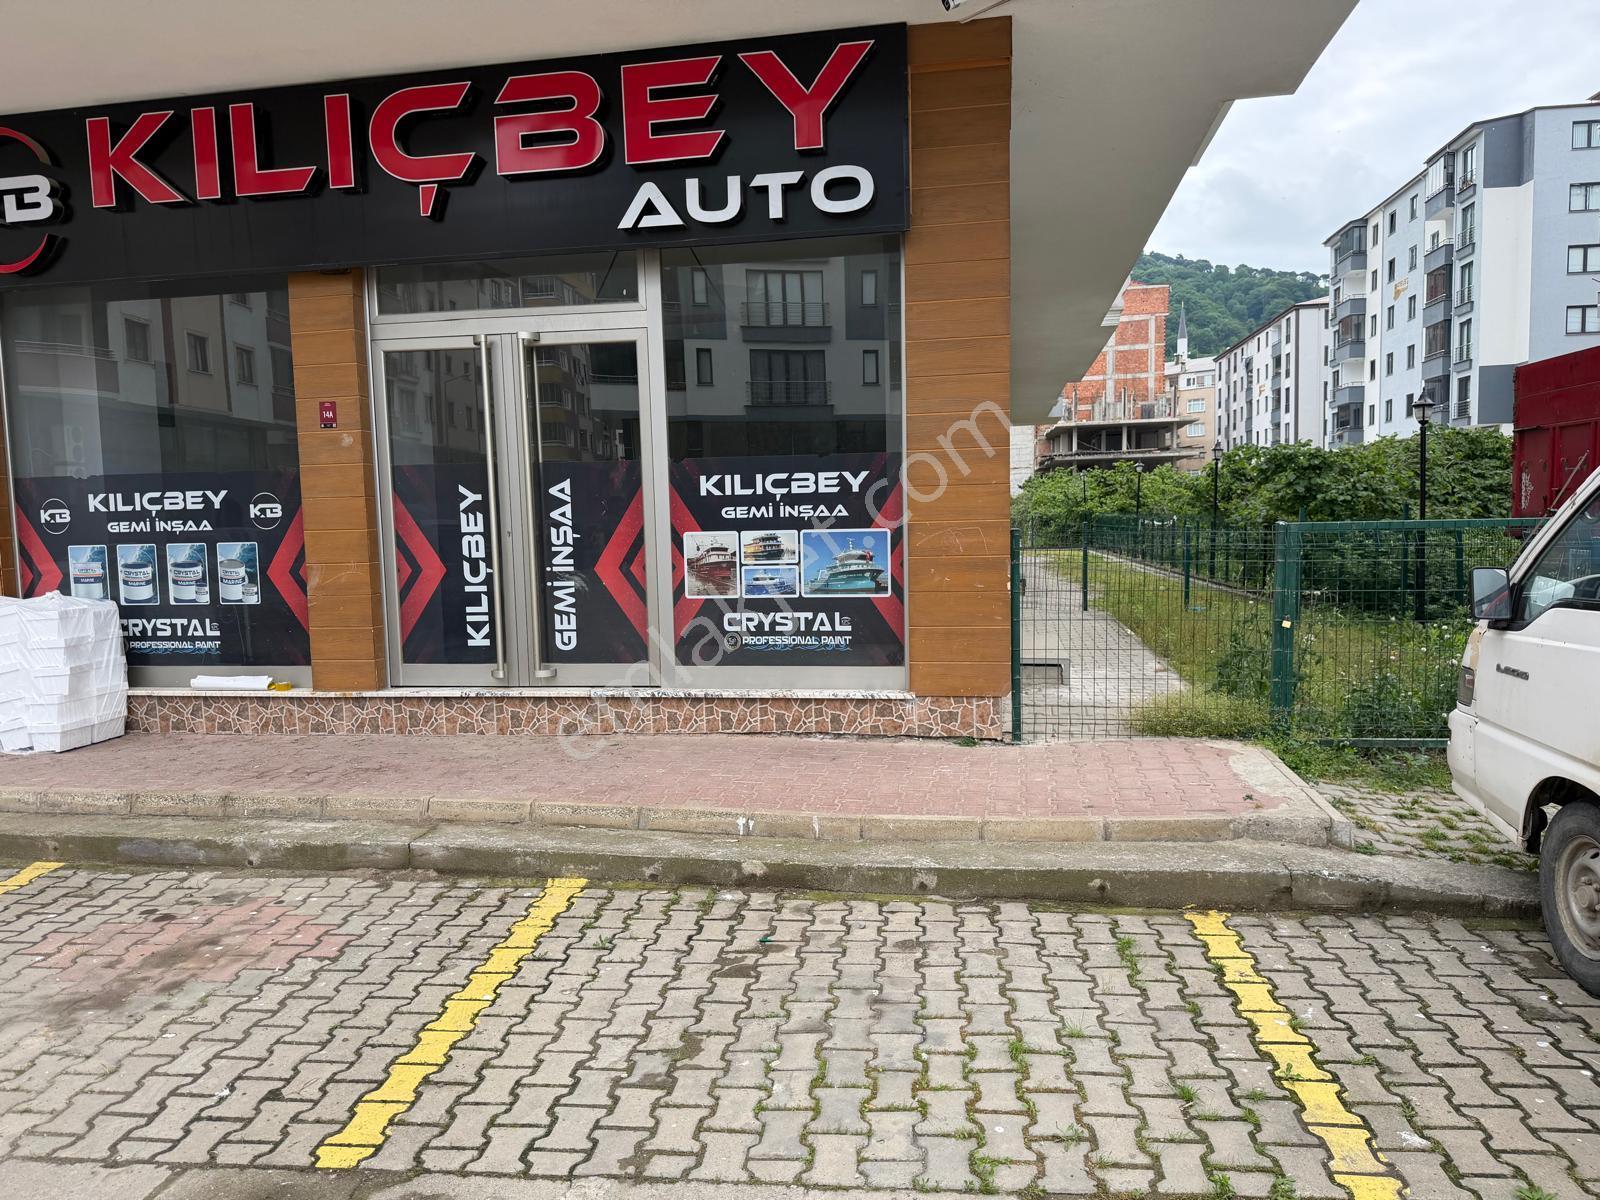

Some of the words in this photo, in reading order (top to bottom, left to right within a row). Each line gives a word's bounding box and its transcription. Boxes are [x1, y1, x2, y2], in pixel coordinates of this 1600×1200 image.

[86, 40, 875, 217] KILIÇBEY
[0, 174, 53, 223] B
[617, 164, 875, 230] AUTO
[699, 470, 870, 501] KILIÇBEY
[87, 489, 228, 517] KILIÇBEY
[721, 502, 773, 519] GEMİ
[779, 503, 849, 521] İNŞAA
[107, 517, 150, 533] GEMİ
[155, 518, 213, 535] İNŞAA
[546, 478, 581, 572] İNŞAA
[458, 484, 494, 647] KILIÇBEY
[546, 581, 578, 651] GEMİ
[723, 611, 852, 632] CRYSTAL
[129, 640, 193, 649] PROFESSIONAL
[195, 640, 221, 649] PAINT
[742, 635, 819, 645] PROFESSIONAL
[820, 635, 852, 645] PAINT
